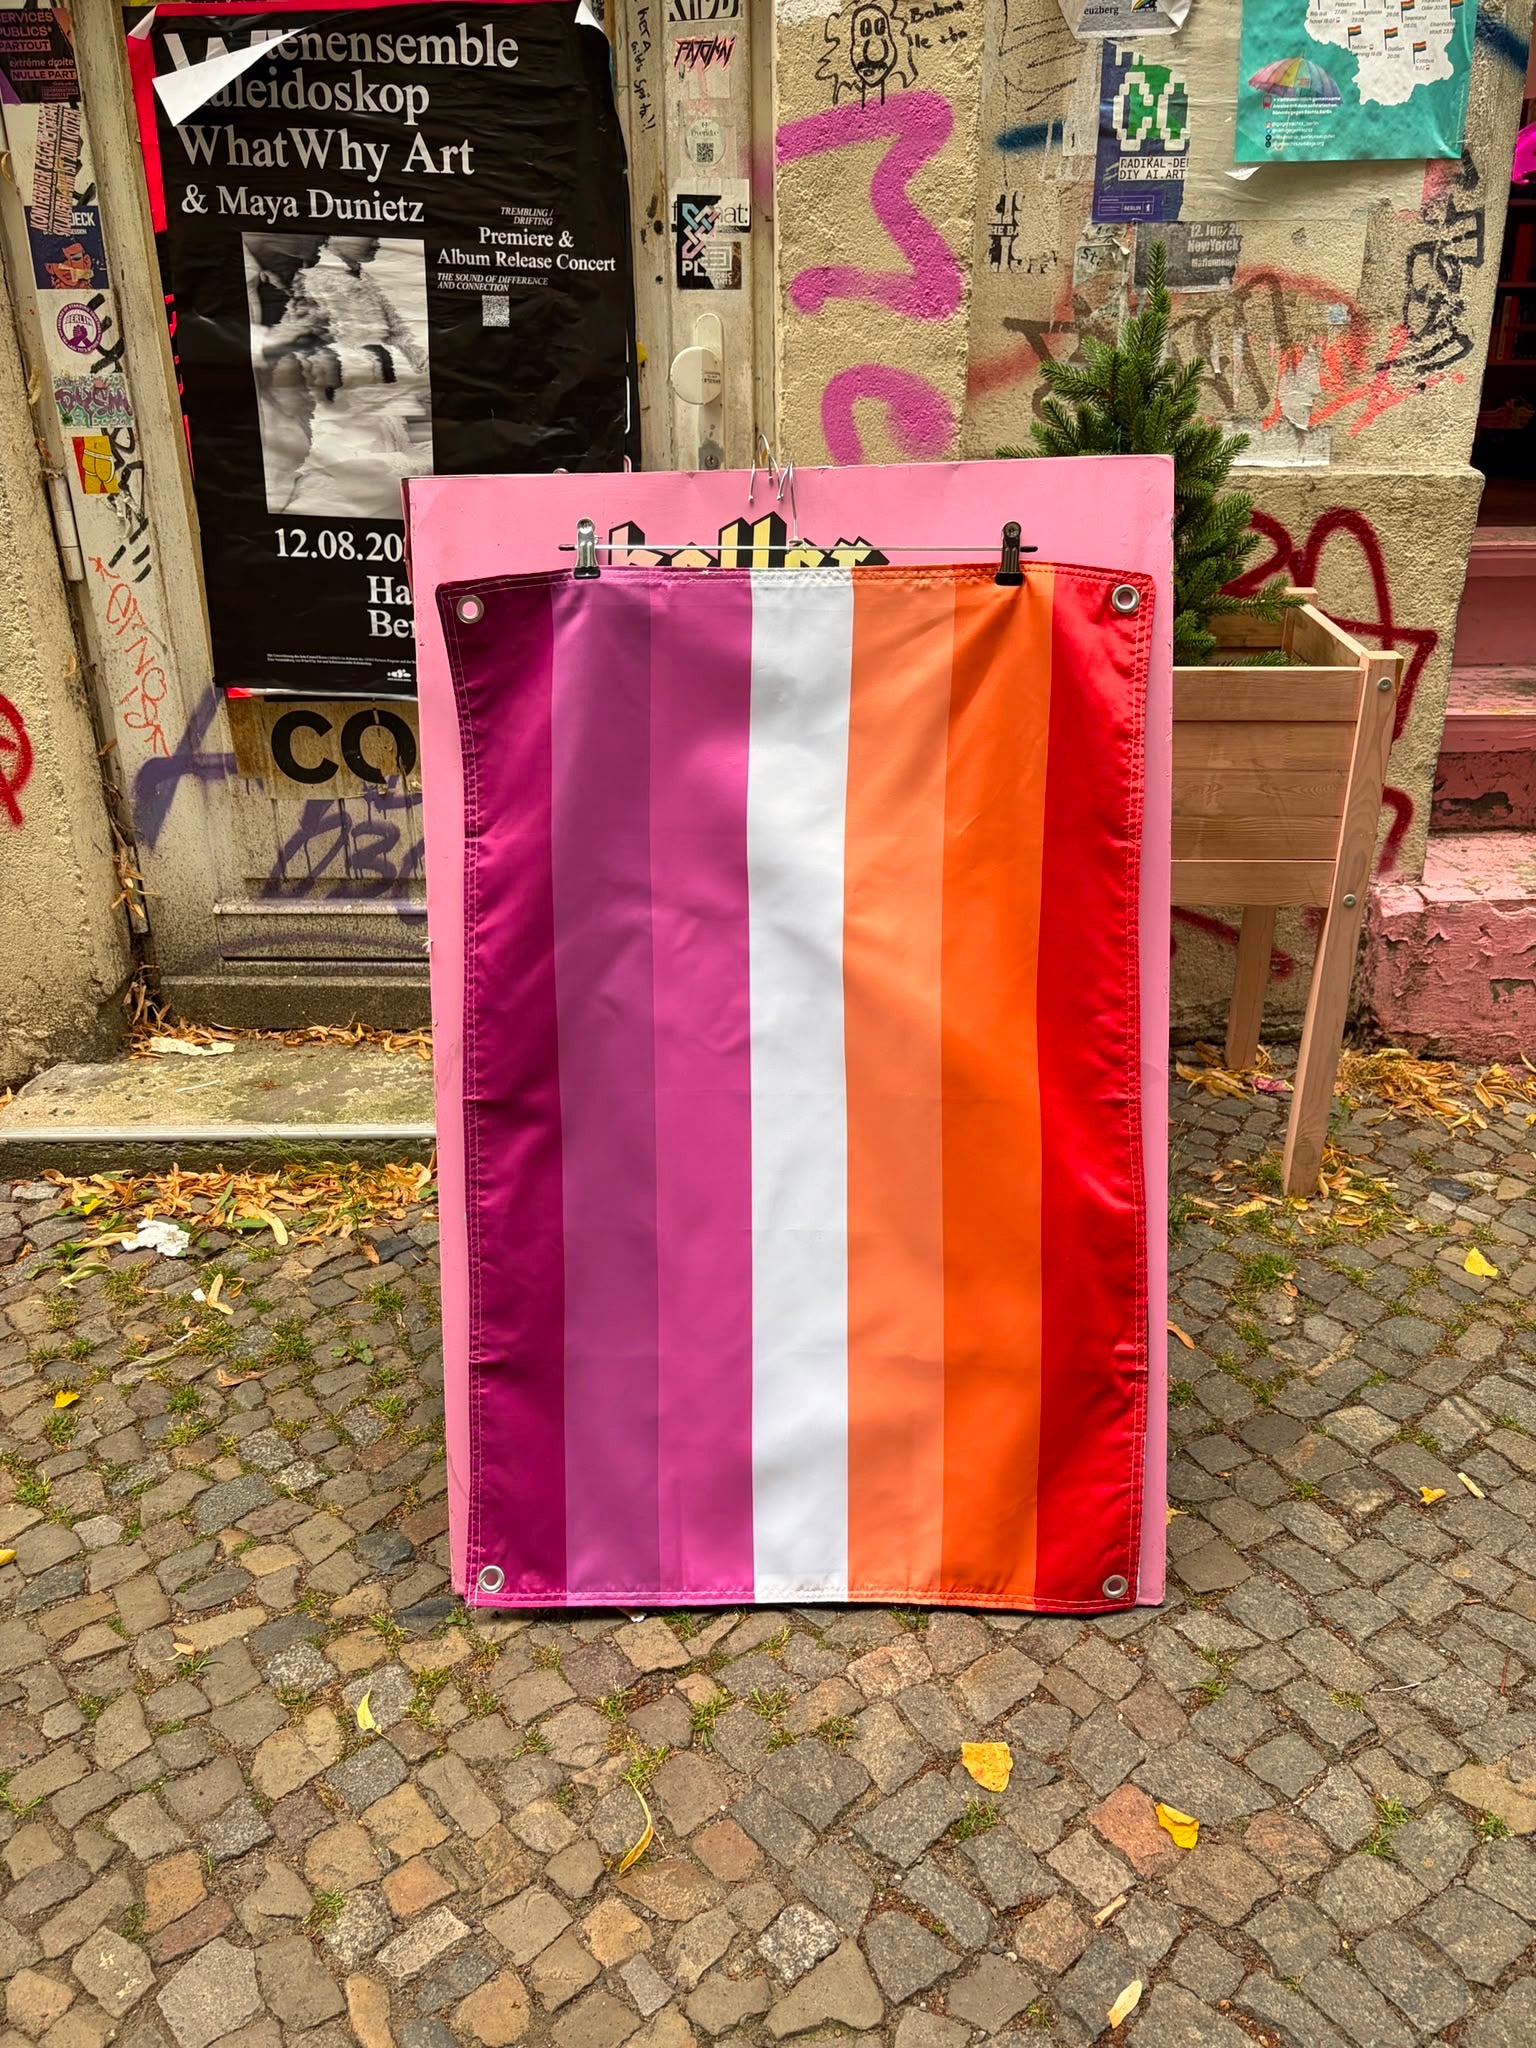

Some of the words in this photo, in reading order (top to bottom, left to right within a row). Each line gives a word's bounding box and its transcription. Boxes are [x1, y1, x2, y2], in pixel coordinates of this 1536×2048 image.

[48, 56, 74, 67] droite
[12, 71, 46, 80] NULLE
[48, 70, 75, 79] PART
[401, 131, 476, 176] Art
[1119, 170, 1141, 180] DIY
[180, 184, 209, 215] &
[216, 185, 300, 225] Maya
[306, 188, 425, 224] Dunietz
[500, 206, 549, 218] TREMBLING
[513, 217, 554, 227] DRIFTING
[478, 226, 554, 248] Premiere
[558, 230, 575, 249] &
[437, 247, 491, 267] Album
[495, 250, 552, 269] Release
[556, 253, 616, 272] Concert
[437, 272, 454, 282] THE
[455, 273, 484, 283] SOUND
[485, 274, 498, 284] OF
[498, 275, 549, 286] DIFFERENCE
[437, 281, 456, 291] AND
[456, 282, 510, 292] CONNECTION
[273, 526, 406, 563] 12.08.20
